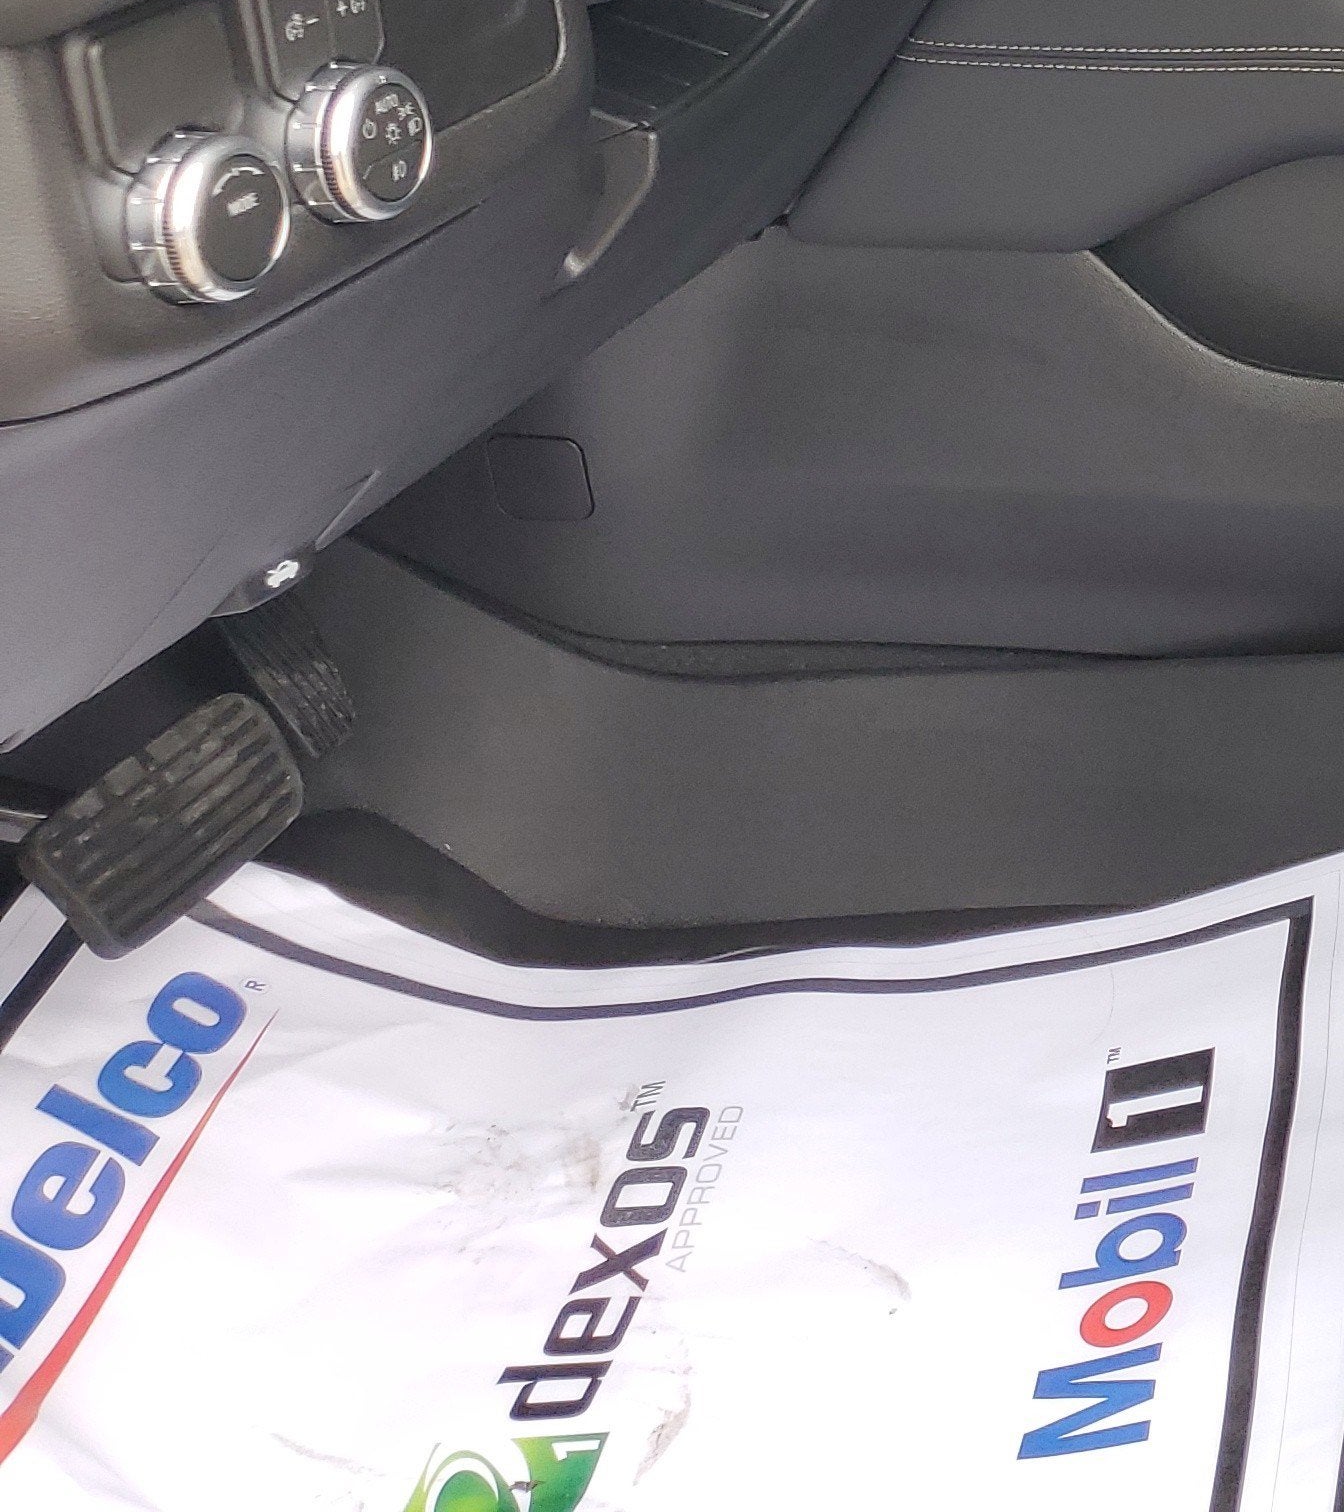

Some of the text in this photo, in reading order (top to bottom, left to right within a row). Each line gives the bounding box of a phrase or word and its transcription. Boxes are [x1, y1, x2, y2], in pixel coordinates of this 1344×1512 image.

[0, 971, 247, 1374] Delco
[497, 1106, 711, 1421] dexos
[665, 1105, 744, 1272] APPROVED
[1017, 1157, 1199, 1460] Mobil
